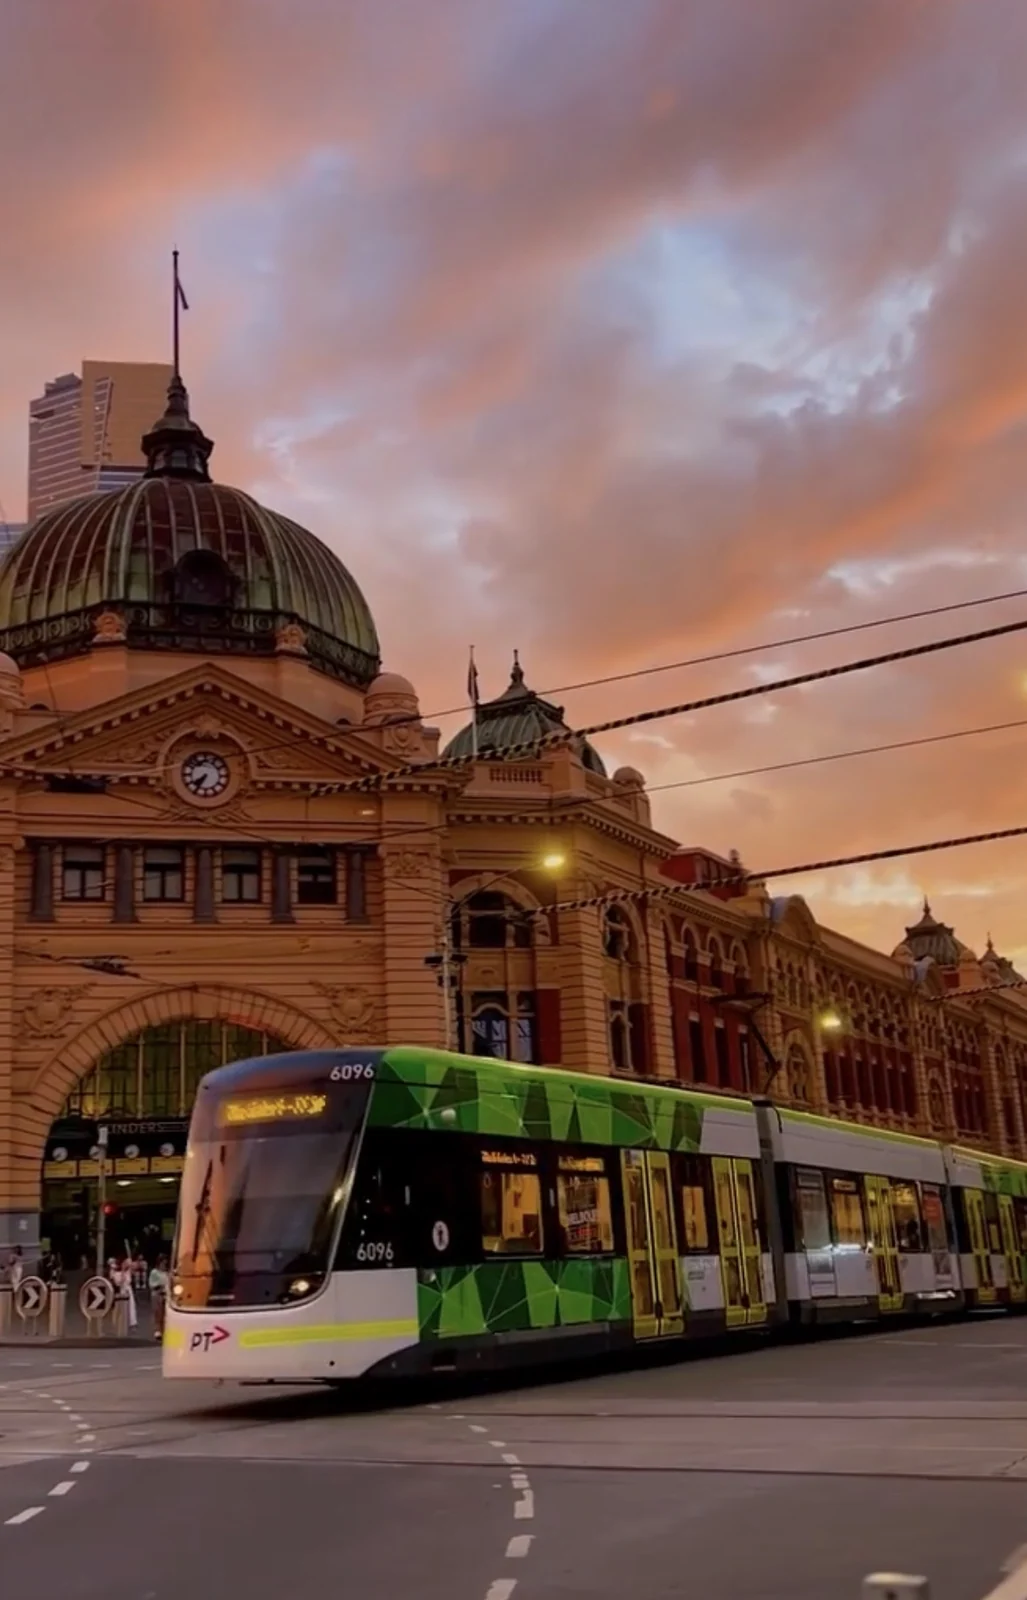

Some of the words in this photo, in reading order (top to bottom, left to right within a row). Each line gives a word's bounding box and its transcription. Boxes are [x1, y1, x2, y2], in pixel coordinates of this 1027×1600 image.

[330, 1062, 374, 1080] 6096
[356, 1242, 395, 1261] 6096
[190, 1331, 214, 1352] PT
